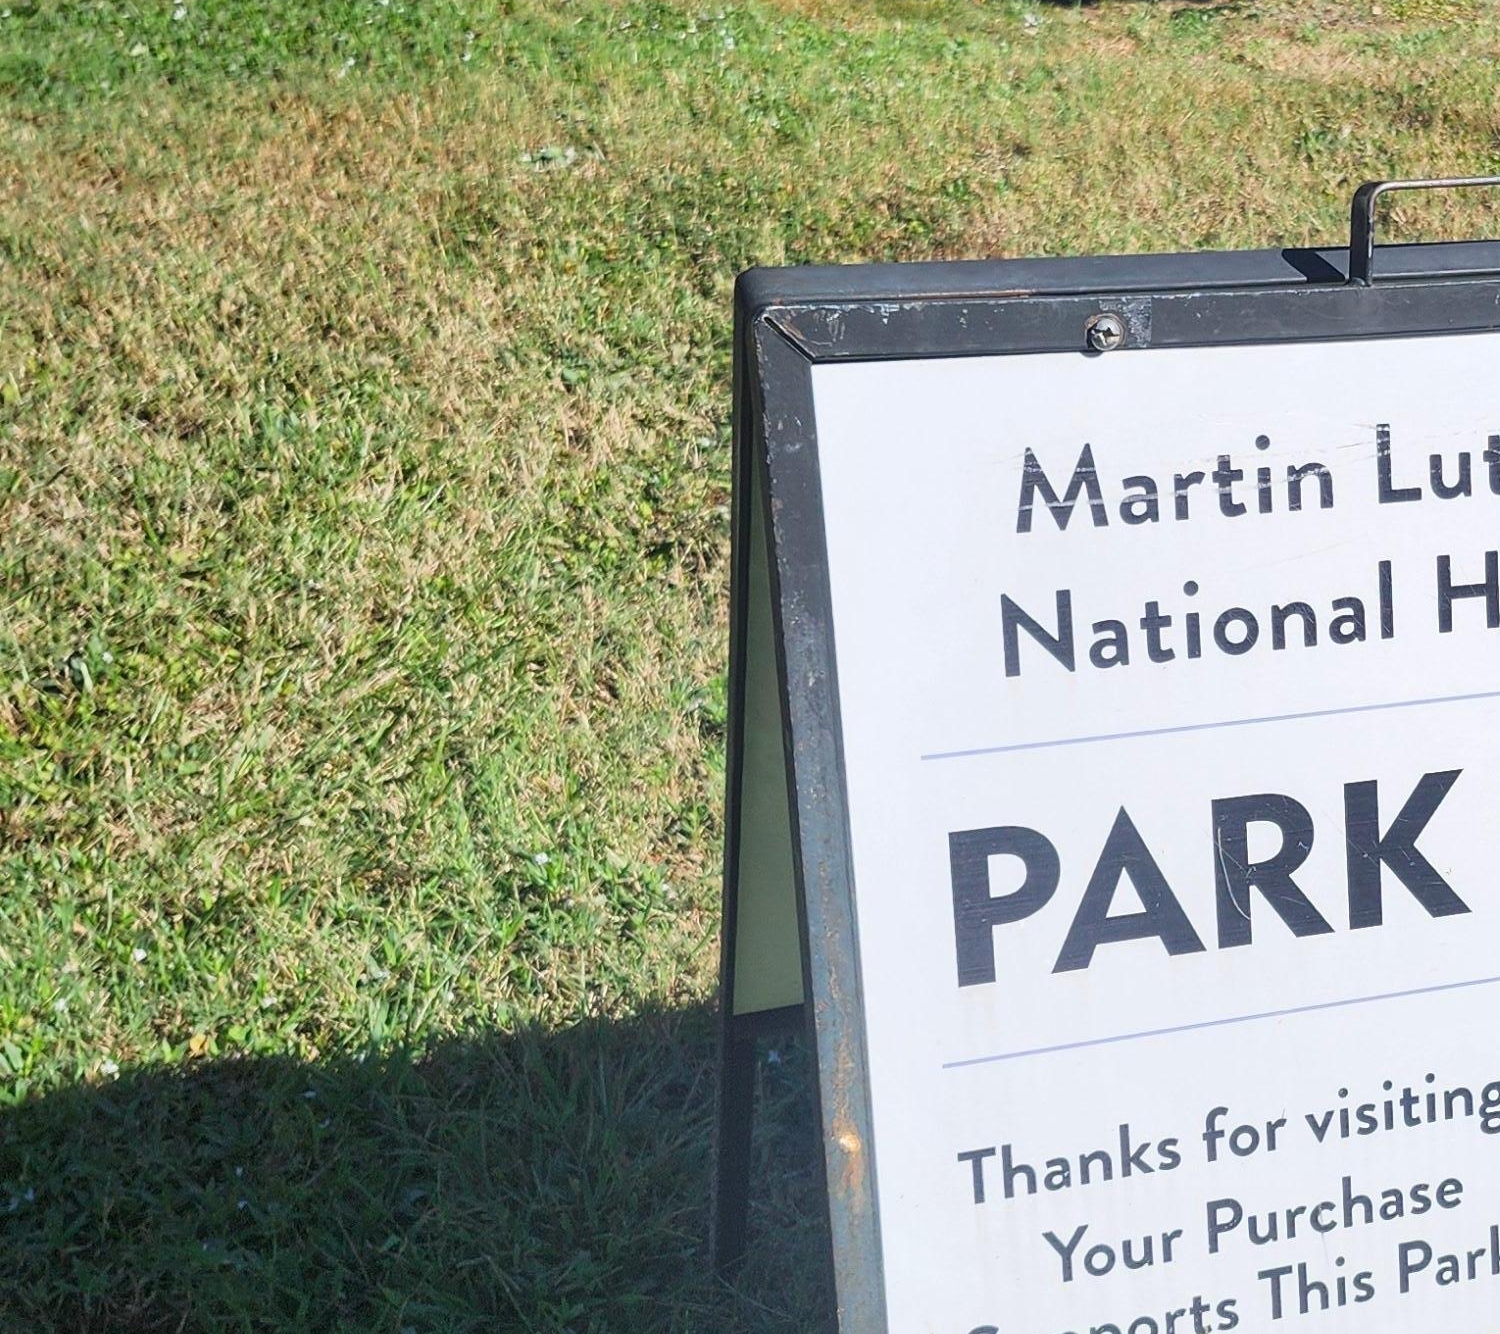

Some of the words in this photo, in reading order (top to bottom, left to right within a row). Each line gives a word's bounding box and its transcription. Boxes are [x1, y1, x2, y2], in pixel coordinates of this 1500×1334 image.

[1015, 433, 1335, 535] Martin
[999, 558, 1395, 678] National
[947, 767, 1474, 989] PARK
[956, 1105, 1184, 1205] Thanks
[1201, 1105, 1288, 1164] for
[1041, 1223, 1184, 1284] Your
[1205, 1175, 1464, 1255] Purchase
[1256, 1259, 1376, 1321] This
